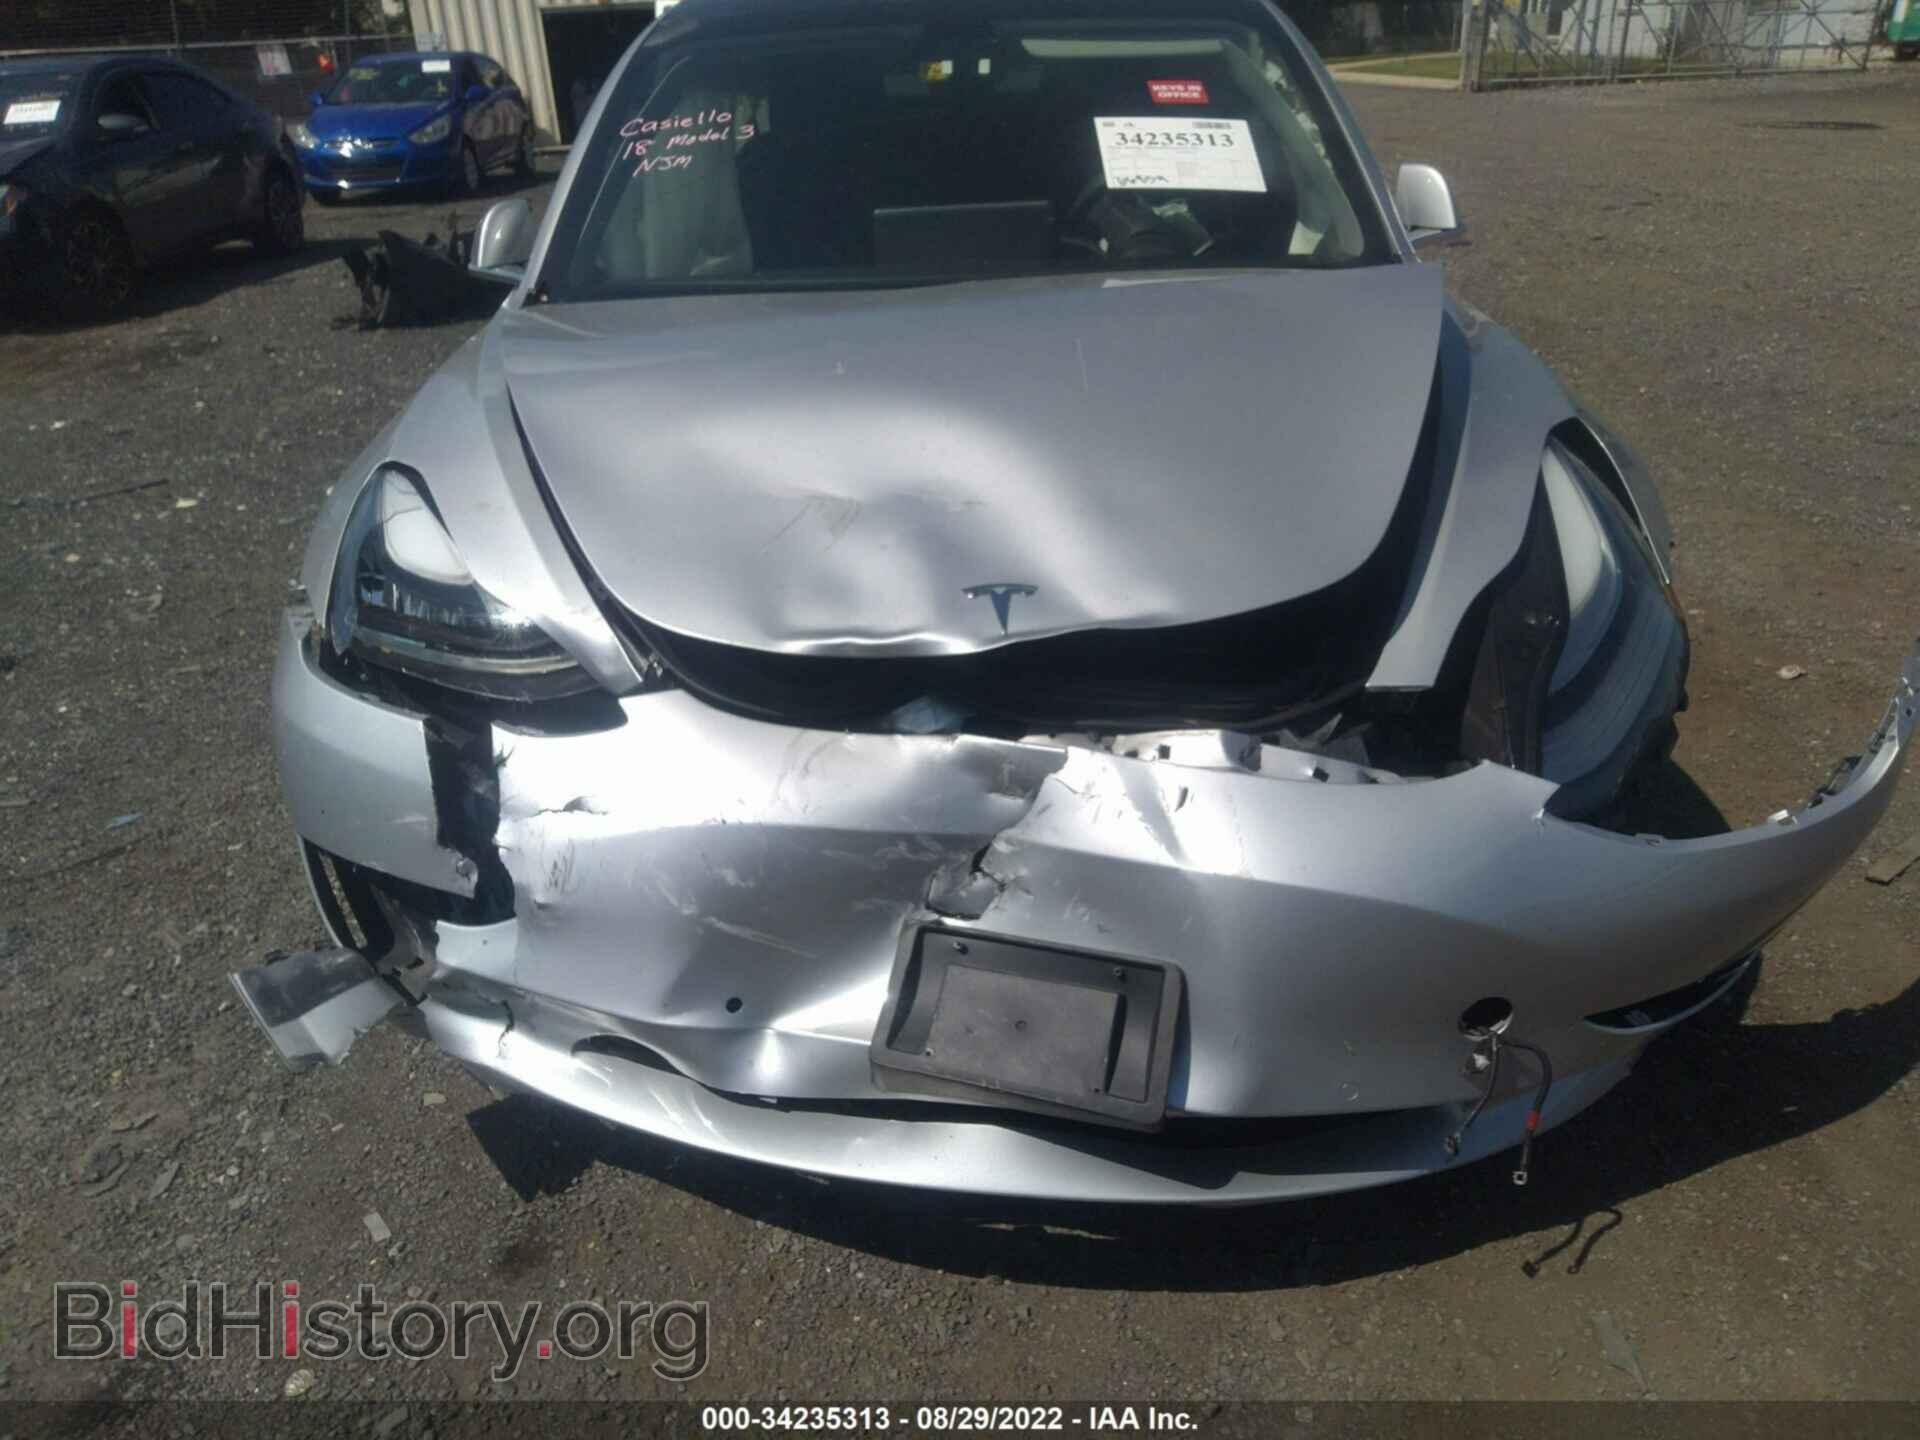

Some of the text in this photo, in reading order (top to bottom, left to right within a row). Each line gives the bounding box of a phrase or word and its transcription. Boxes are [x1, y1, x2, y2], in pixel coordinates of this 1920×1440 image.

[619, 109, 732, 137] Casiello
[666, 127, 729, 150] Model
[735, 124, 755, 140] 3
[1115, 132, 1234, 147] 34235313
